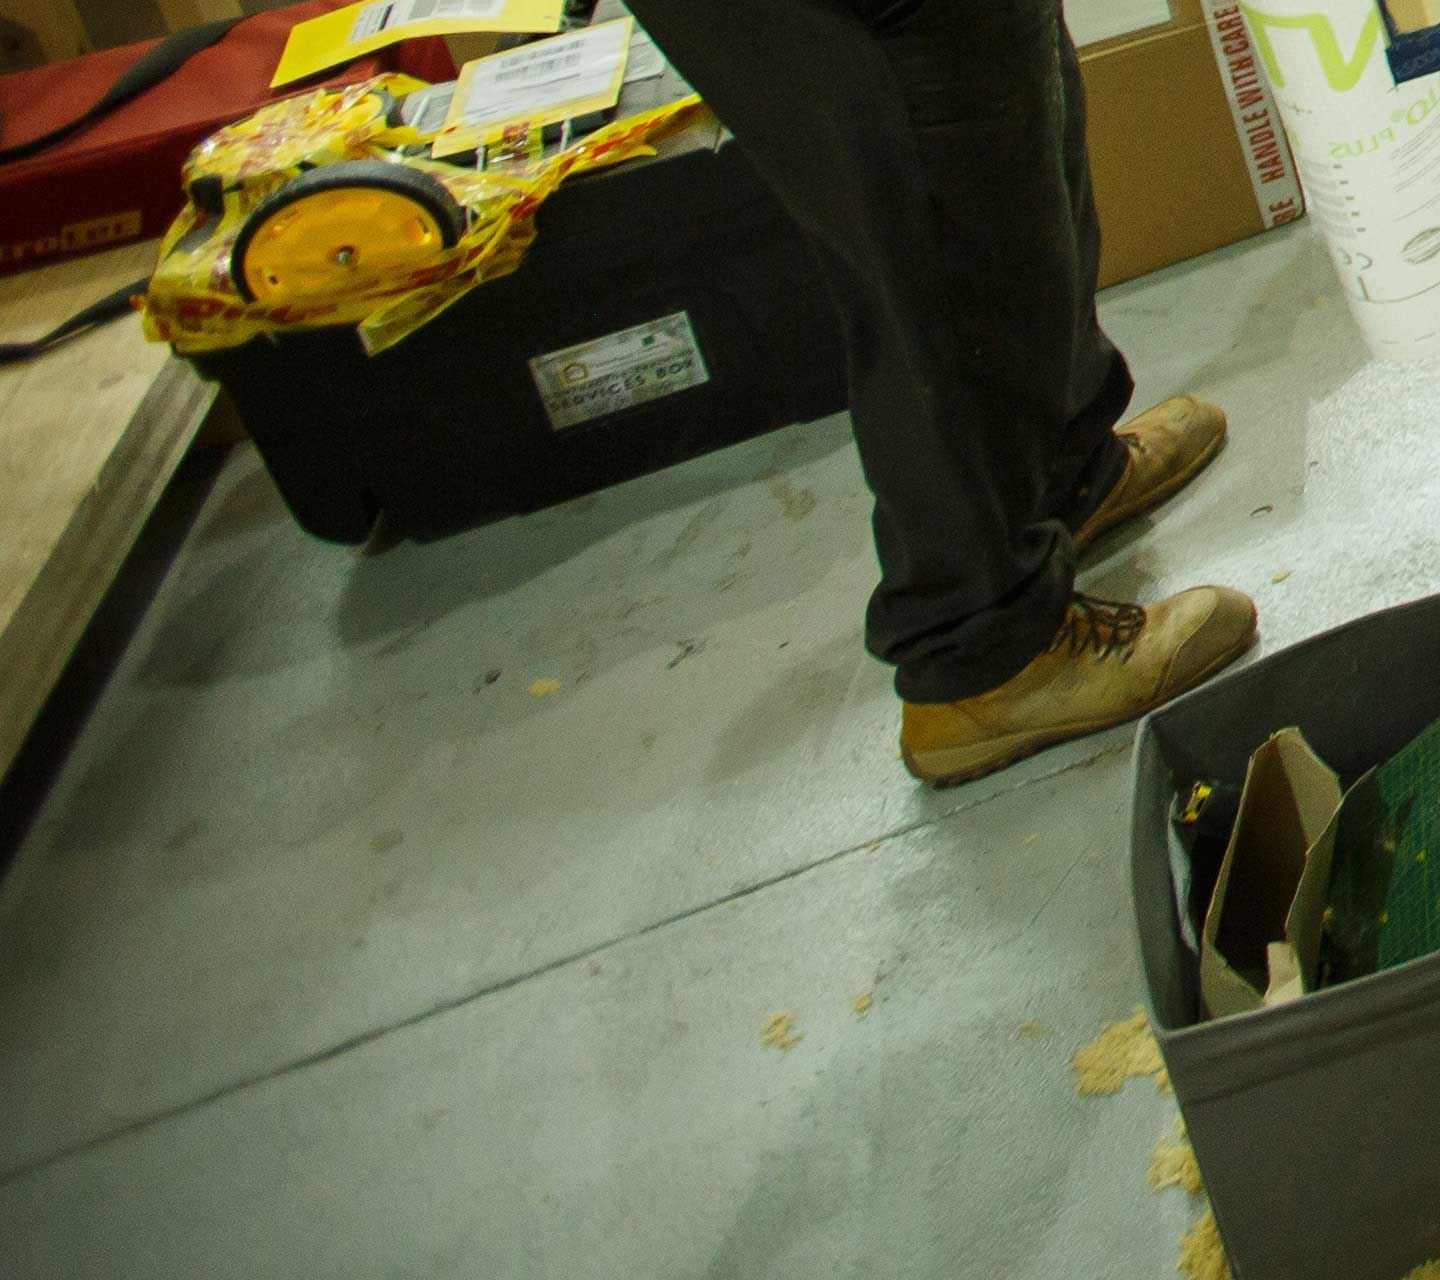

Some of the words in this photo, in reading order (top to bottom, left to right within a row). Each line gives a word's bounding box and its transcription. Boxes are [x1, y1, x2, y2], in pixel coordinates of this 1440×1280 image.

[1212, 4, 1251, 55] CARE
[1228, 54, 1265, 110] WITH
[1242, 106, 1286, 185] HANDLE
